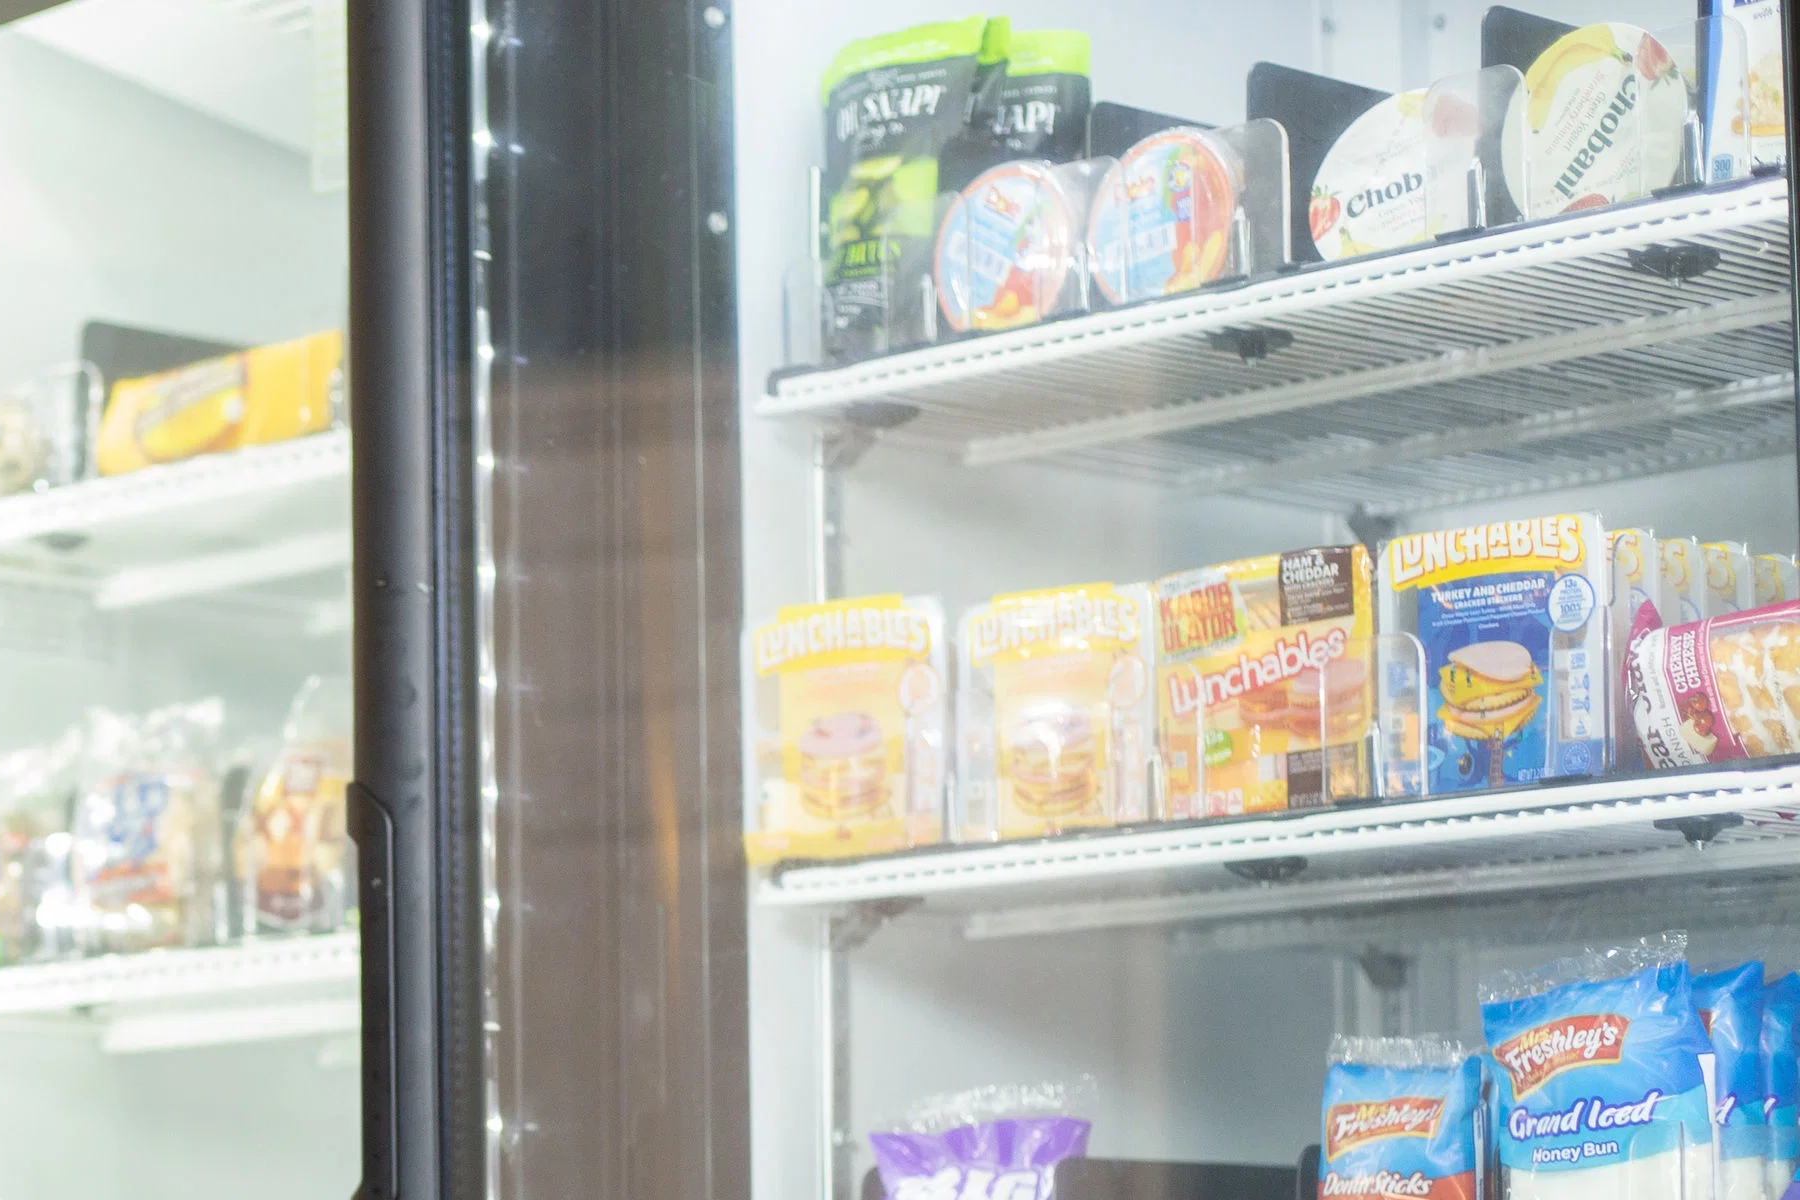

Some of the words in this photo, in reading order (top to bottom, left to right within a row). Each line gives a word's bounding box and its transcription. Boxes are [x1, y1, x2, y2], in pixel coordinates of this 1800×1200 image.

[1554, 74, 1636, 200] Chobani
[1347, 172, 1423, 219] Chob
[1283, 563, 1339, 585] CHEDDAR
[1393, 515, 1582, 585] LUNCHABLES
[1431, 588, 1472, 603] TURKEY
[1473, 585, 1495, 598] AND
[1496, 578, 1546, 594] CHEDDAR
[756, 607, 931, 667] LUNCHABLES
[974, 597, 1137, 656] LUNCHABLES
[1169, 629, 1346, 716] Lunchables
[1668, 634, 1688, 693] CHERRY
[1682, 630, 1702, 690] CHEESE
[1647, 725, 1677, 770] ear
[1504, 1021, 1619, 1080] Freshley's
[1510, 1100, 1584, 1139] Grand
[1588, 1091, 1662, 1131] Iced
[1533, 1147, 1581, 1164] Honey
[1583, 1141, 1618, 1157] Bun
[1372, 1169, 1433, 1196] Sticks
